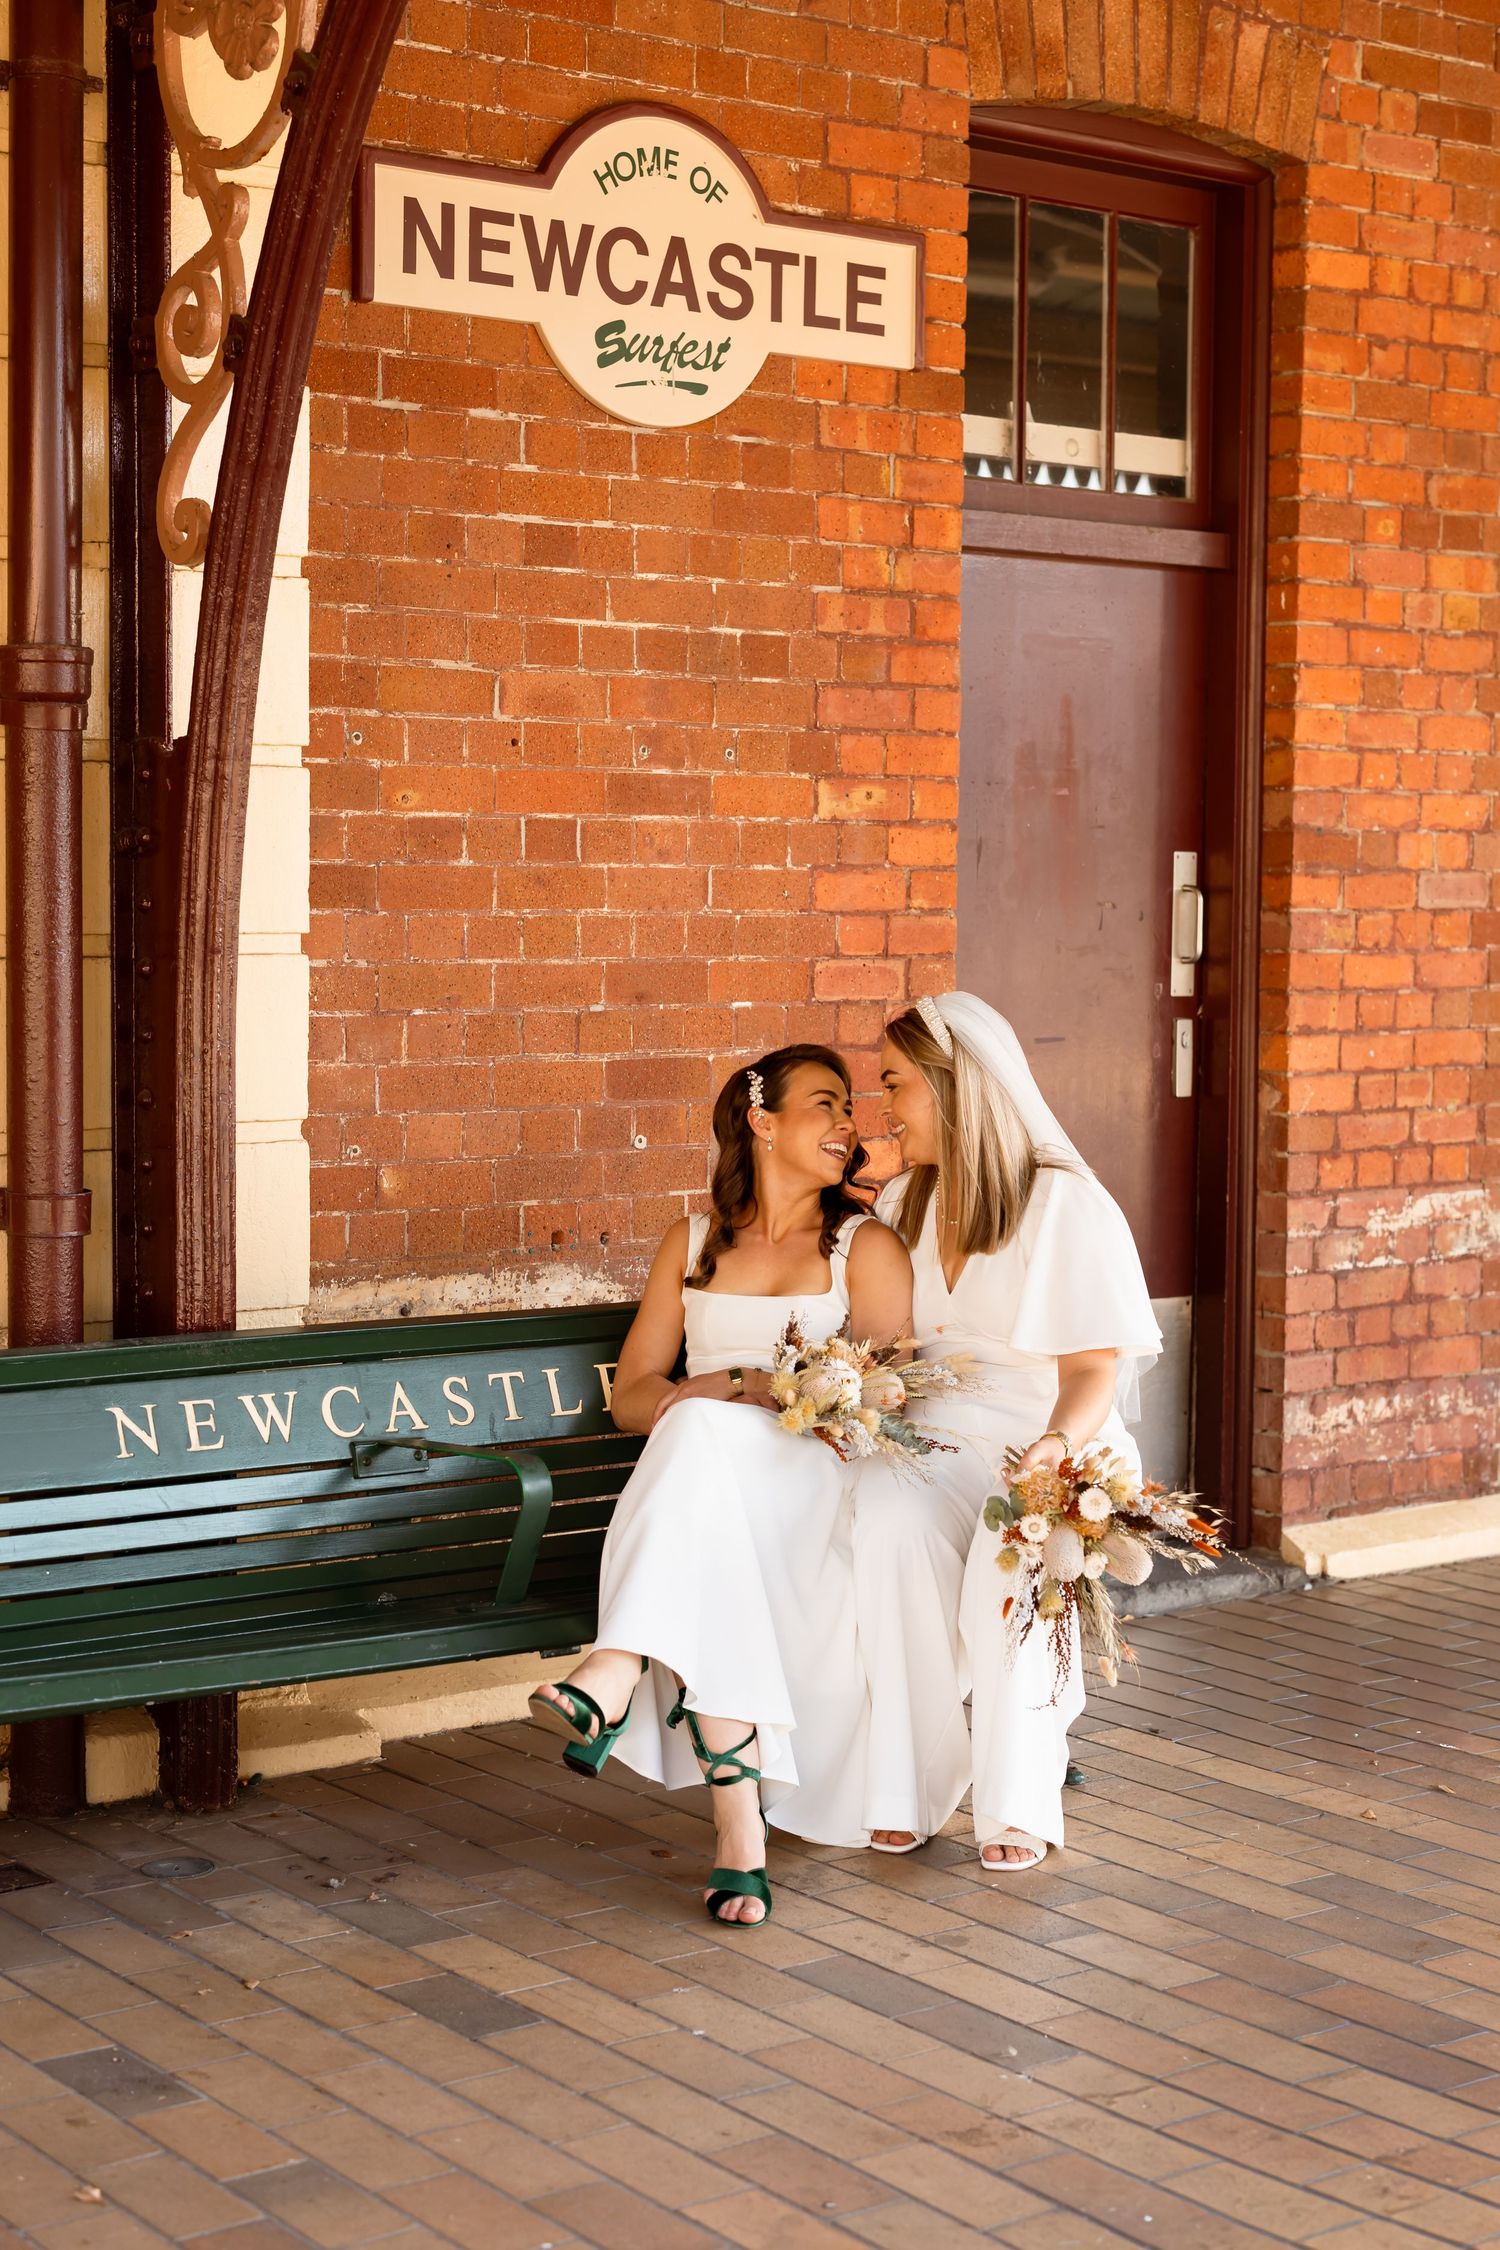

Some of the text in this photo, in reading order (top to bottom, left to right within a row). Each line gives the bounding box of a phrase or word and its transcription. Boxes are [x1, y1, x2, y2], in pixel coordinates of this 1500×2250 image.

[593, 146, 729, 204] HOME OF
[403, 196, 887, 337] NEWCASTLE
[594, 319, 731, 373] Surfest
